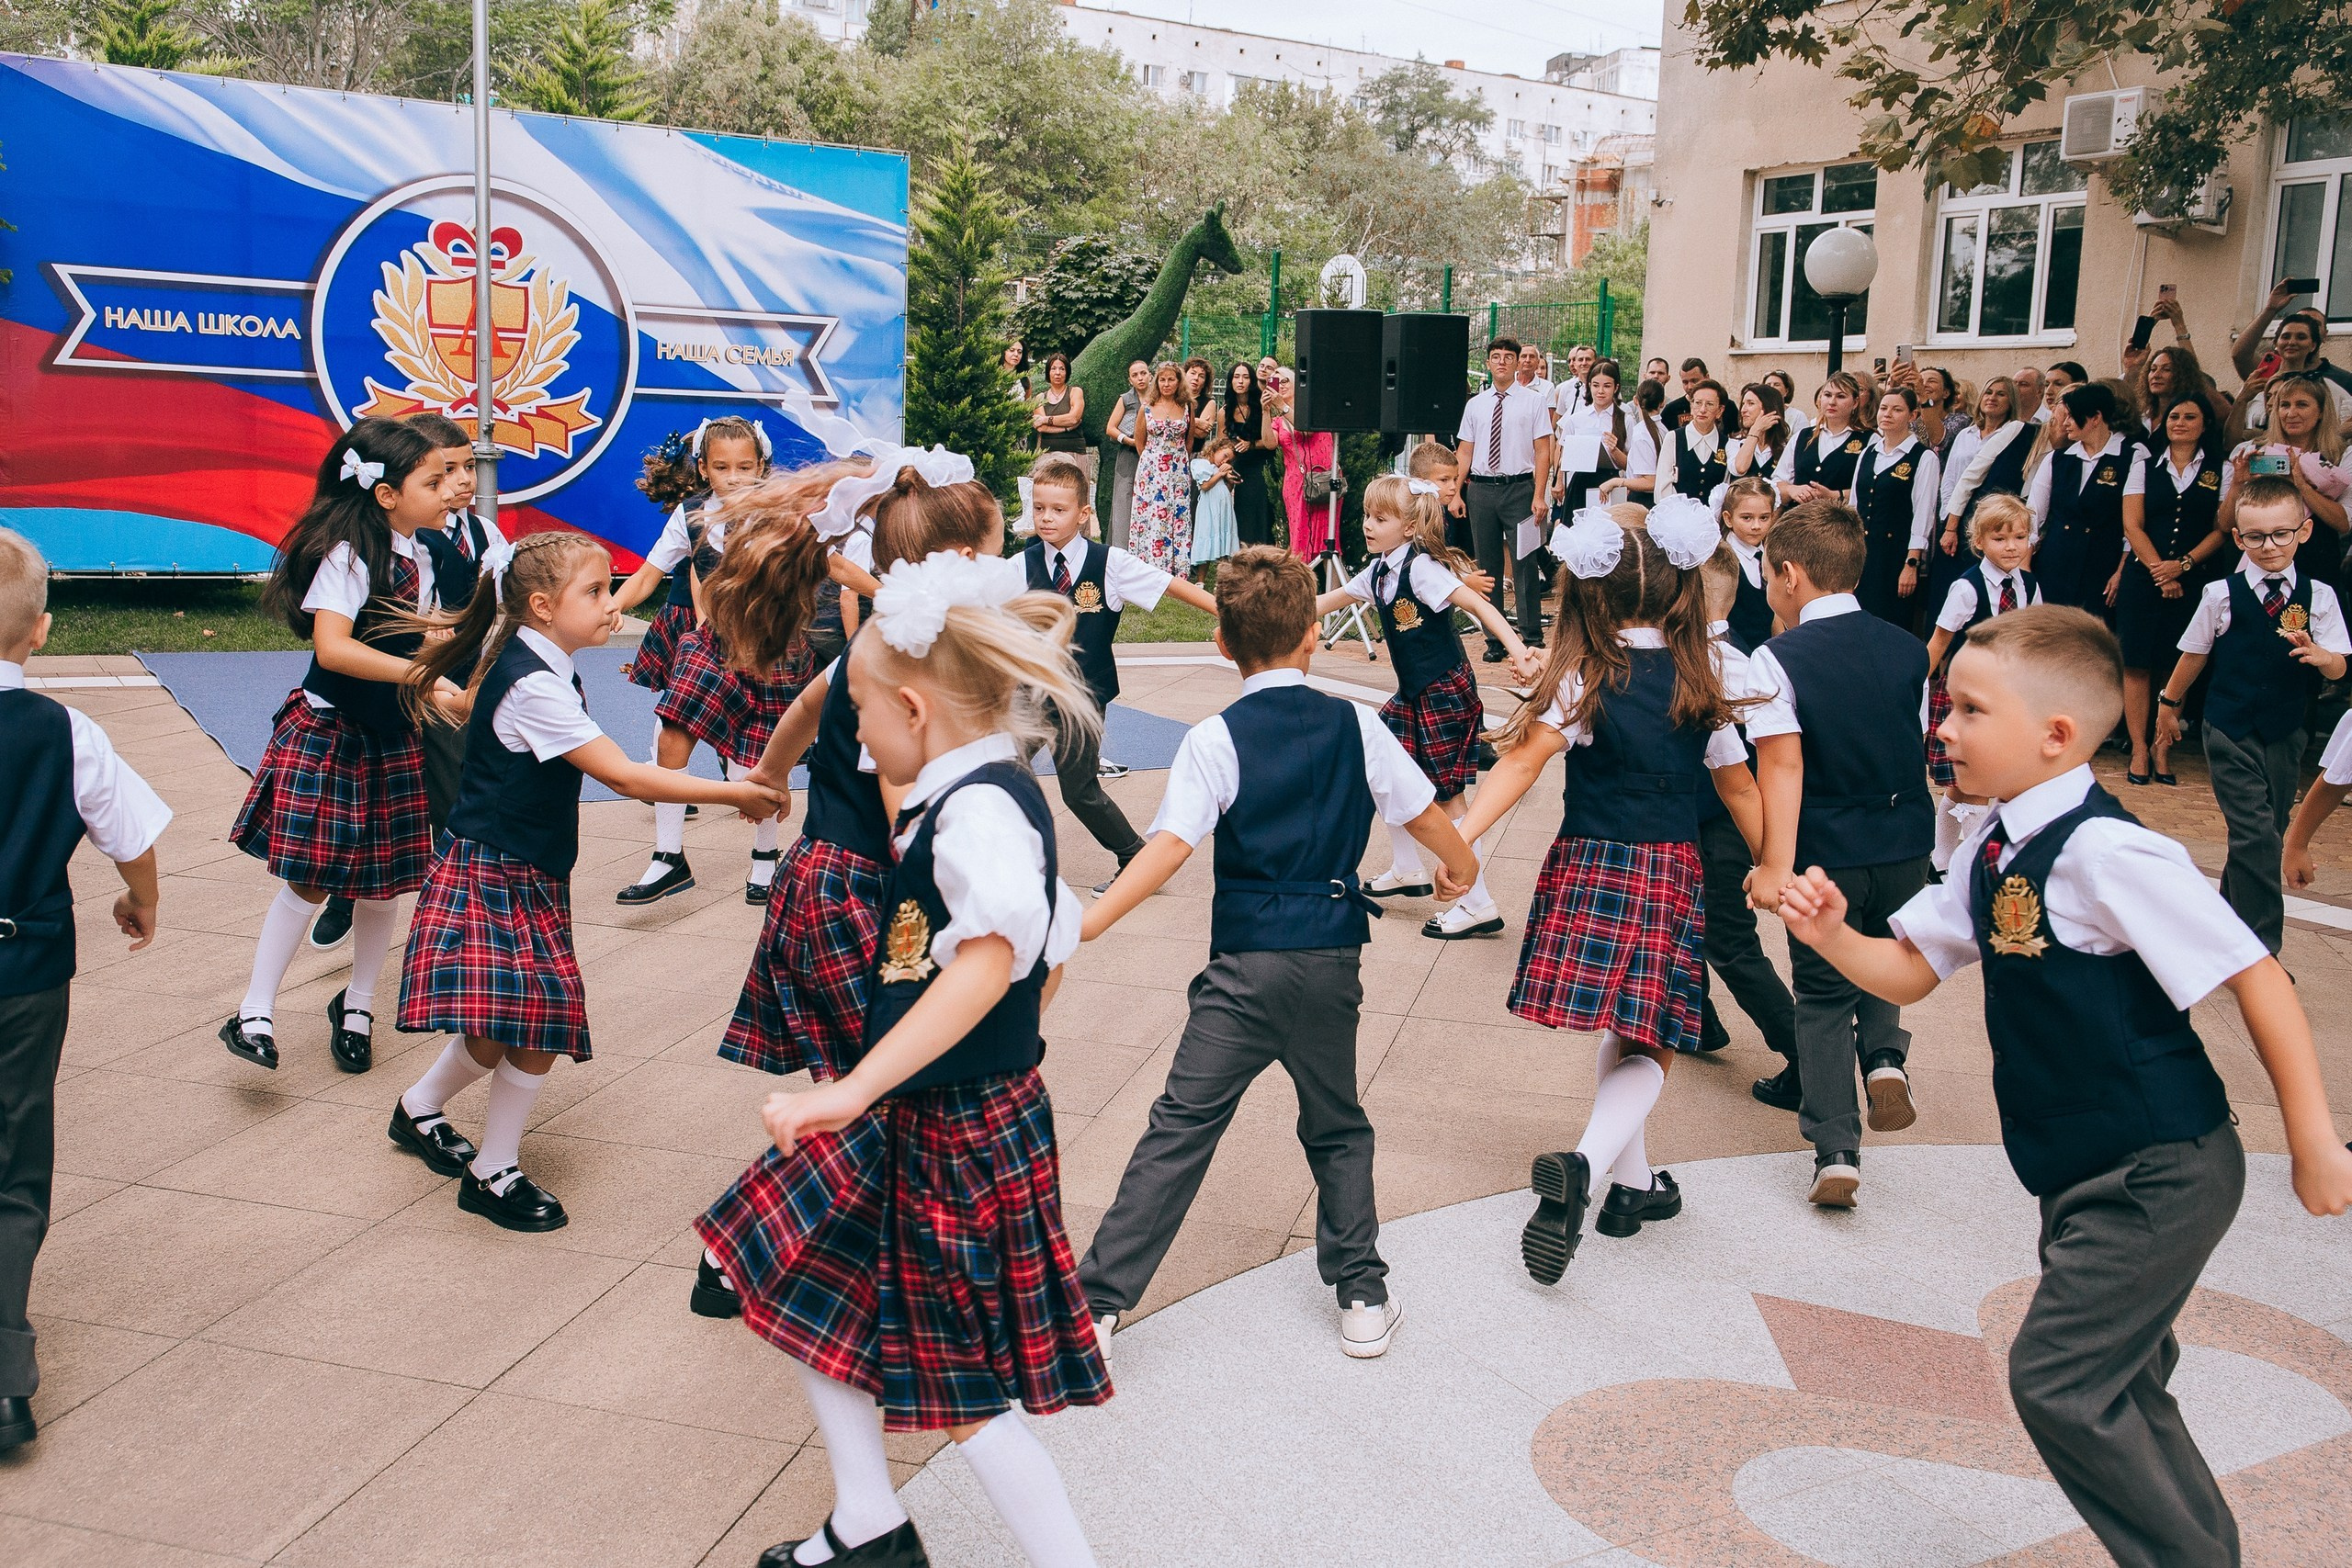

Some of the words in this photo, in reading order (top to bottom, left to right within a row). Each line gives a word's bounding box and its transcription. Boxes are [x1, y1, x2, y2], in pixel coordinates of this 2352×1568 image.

[105, 306, 193, 333] НАША
[198, 312, 301, 340] ШКОЛА
[657, 341, 721, 363] НАША
[725, 344, 795, 367] СЕМЬЯ
